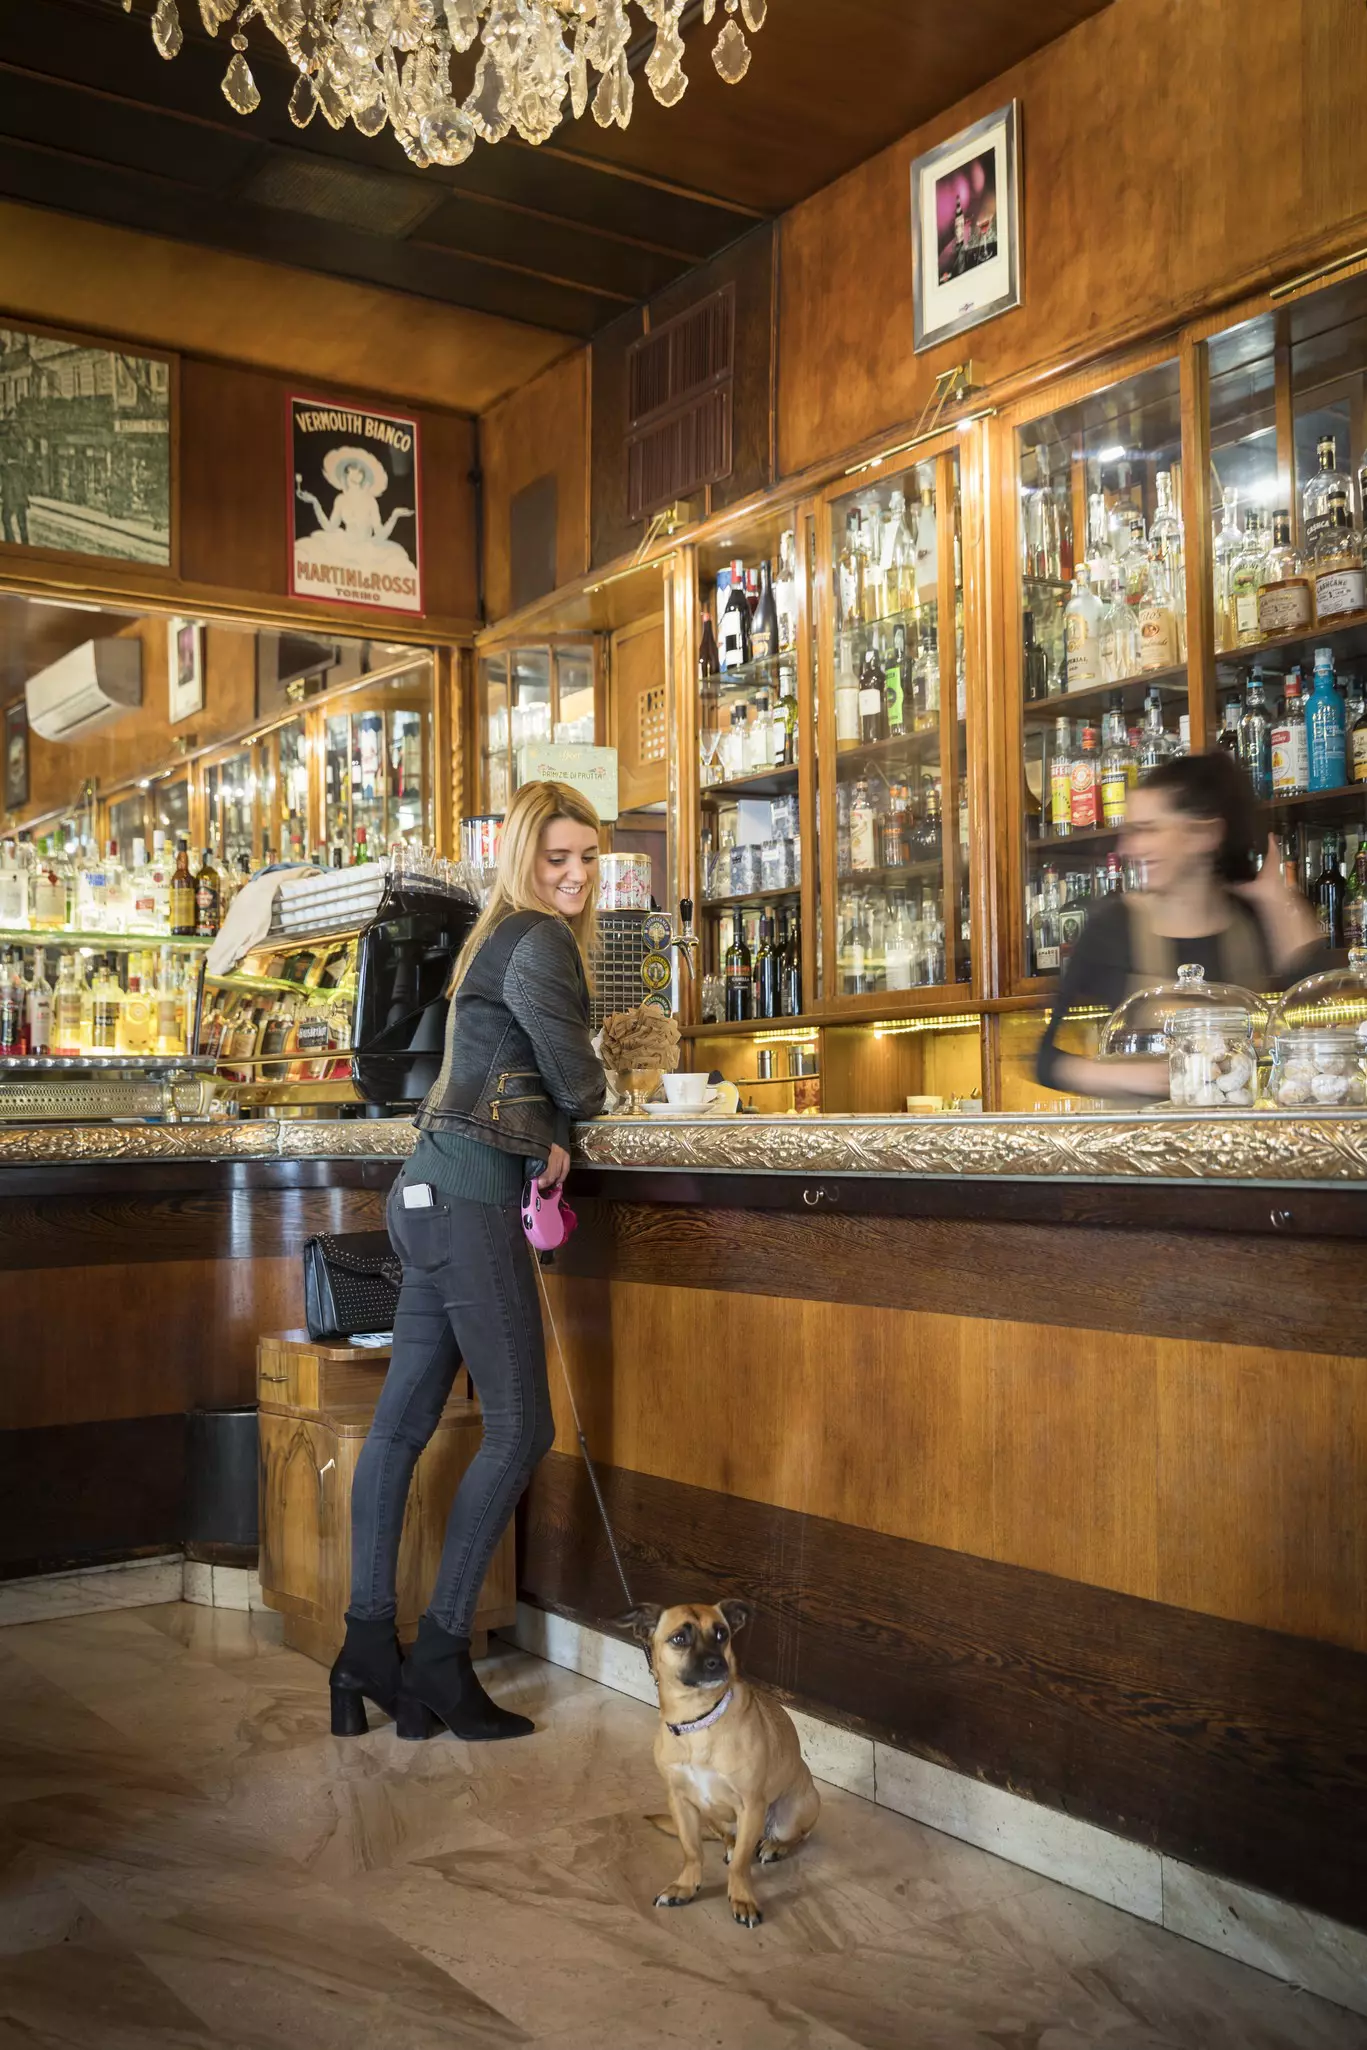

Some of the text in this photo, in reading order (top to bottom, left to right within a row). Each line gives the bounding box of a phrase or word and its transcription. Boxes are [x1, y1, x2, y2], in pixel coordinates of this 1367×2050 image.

[296, 411, 411, 452] VERMOUTH BIANCO
[336, 588, 381, 601] TORINO
[578, 772, 603, 781] FRUTTA
